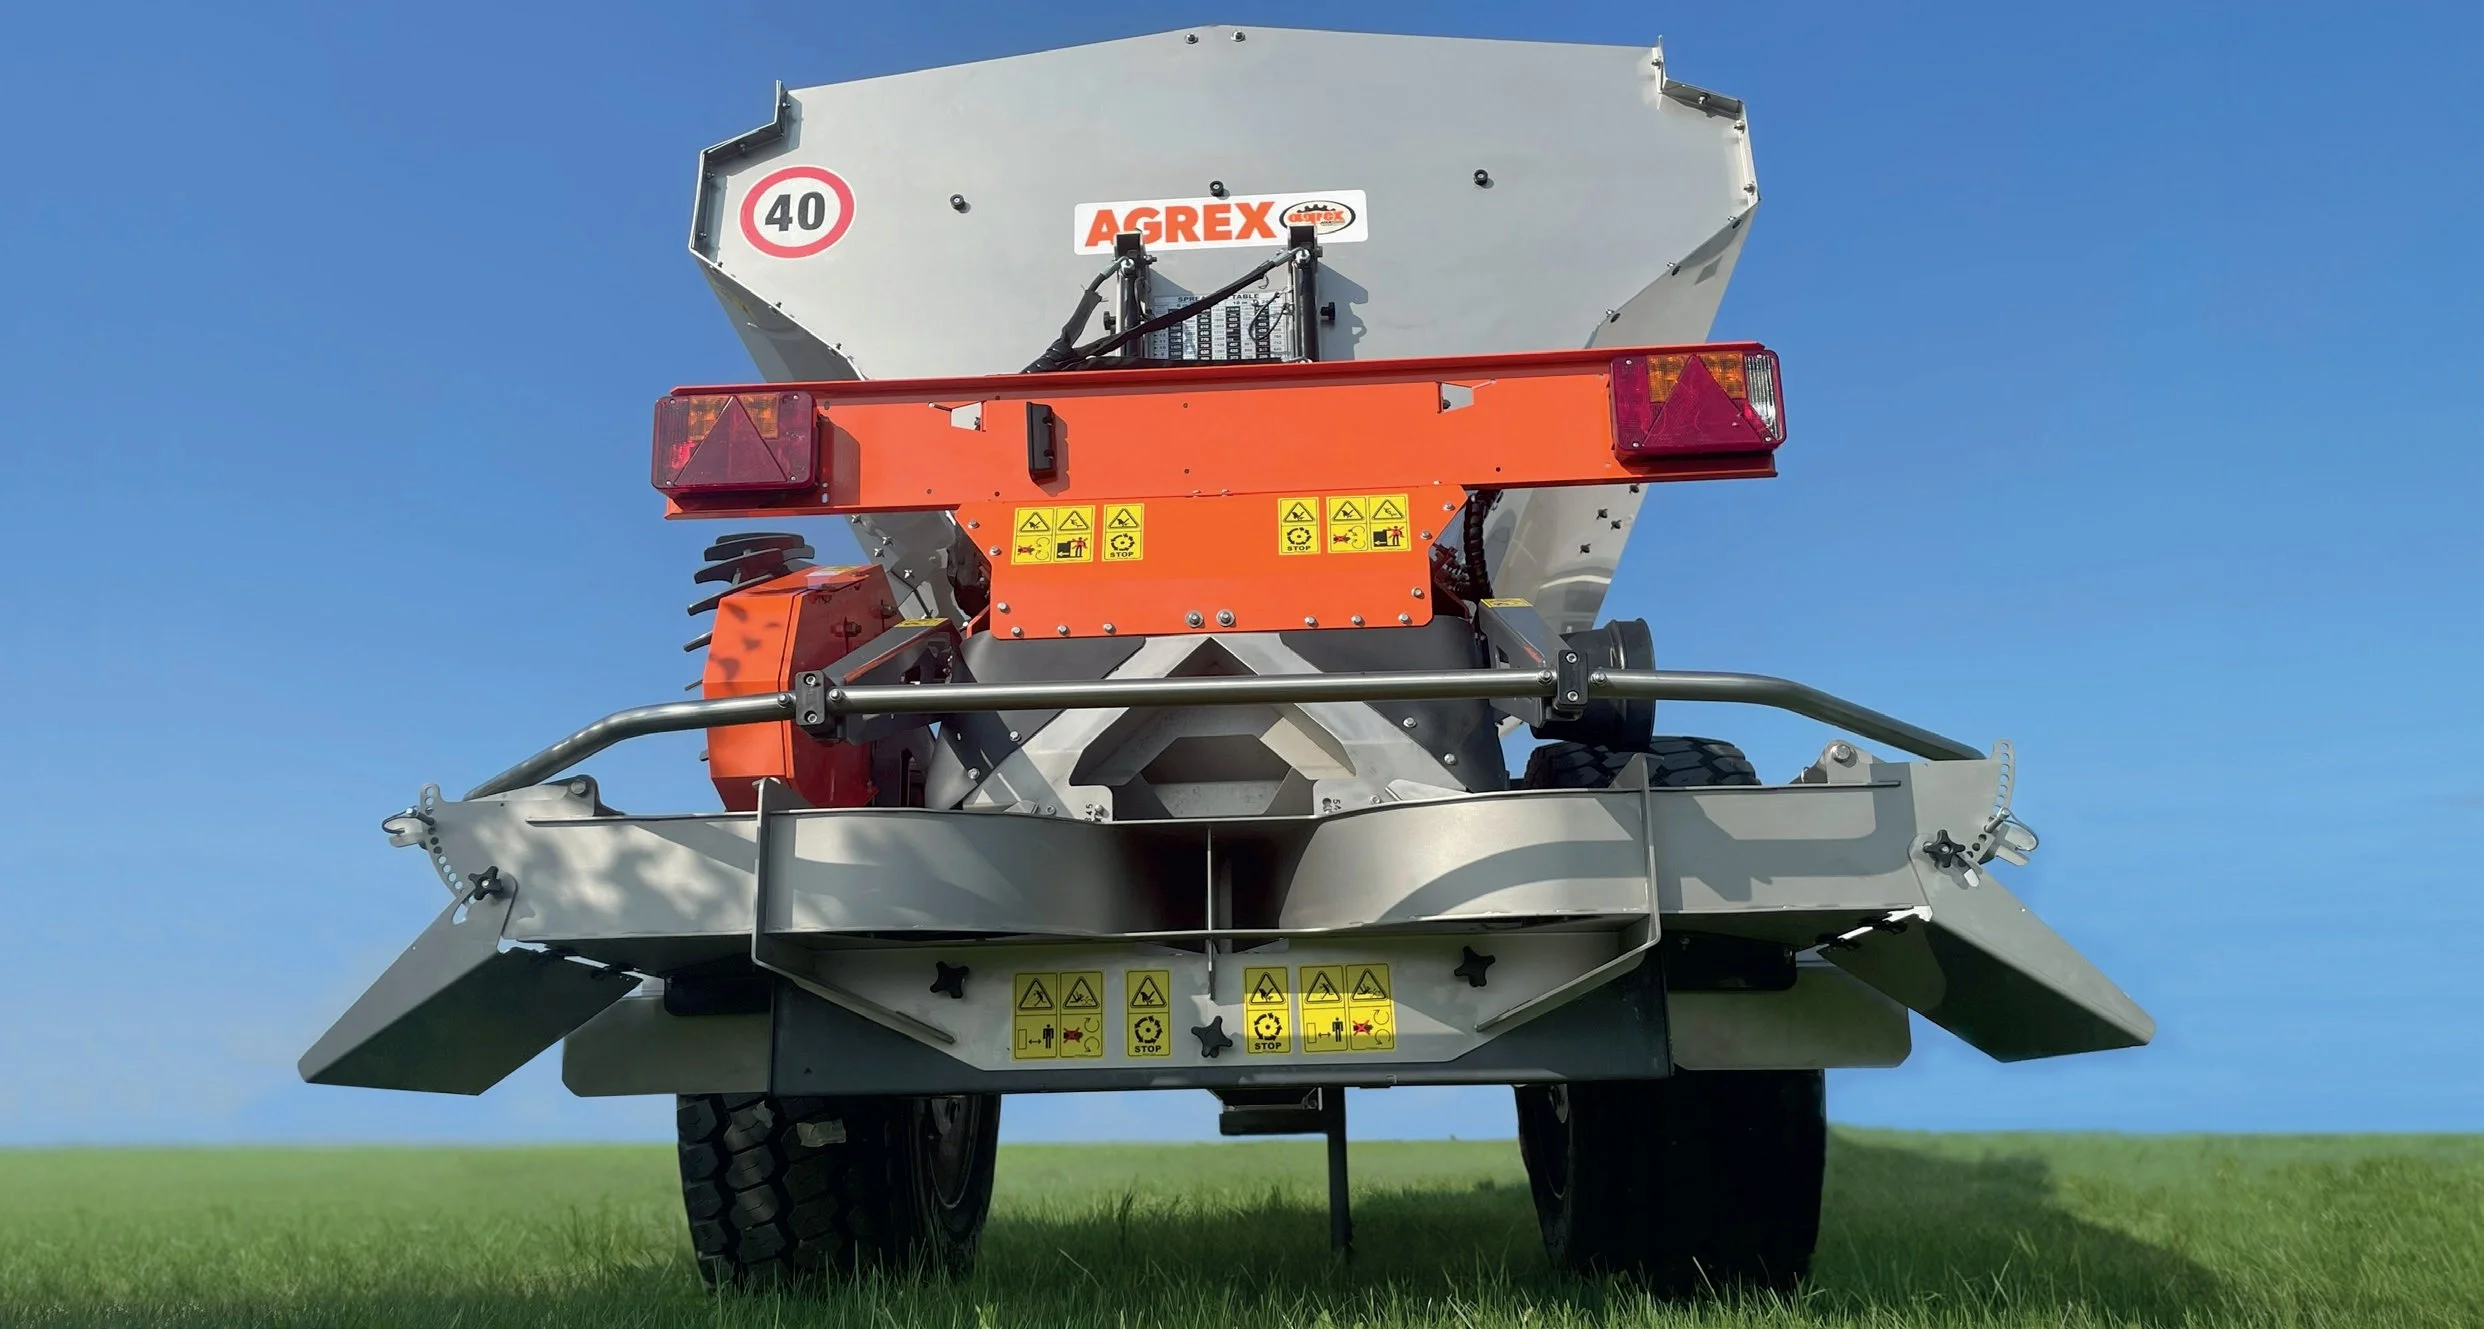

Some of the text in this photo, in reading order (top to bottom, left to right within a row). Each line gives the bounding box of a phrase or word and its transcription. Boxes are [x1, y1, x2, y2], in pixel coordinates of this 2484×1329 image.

[765, 191, 826, 232] 40
[1084, 201, 1278, 247] AGREX
[1134, 1045, 1162, 1053] STOP
[1254, 1042, 1282, 1050] STOP
